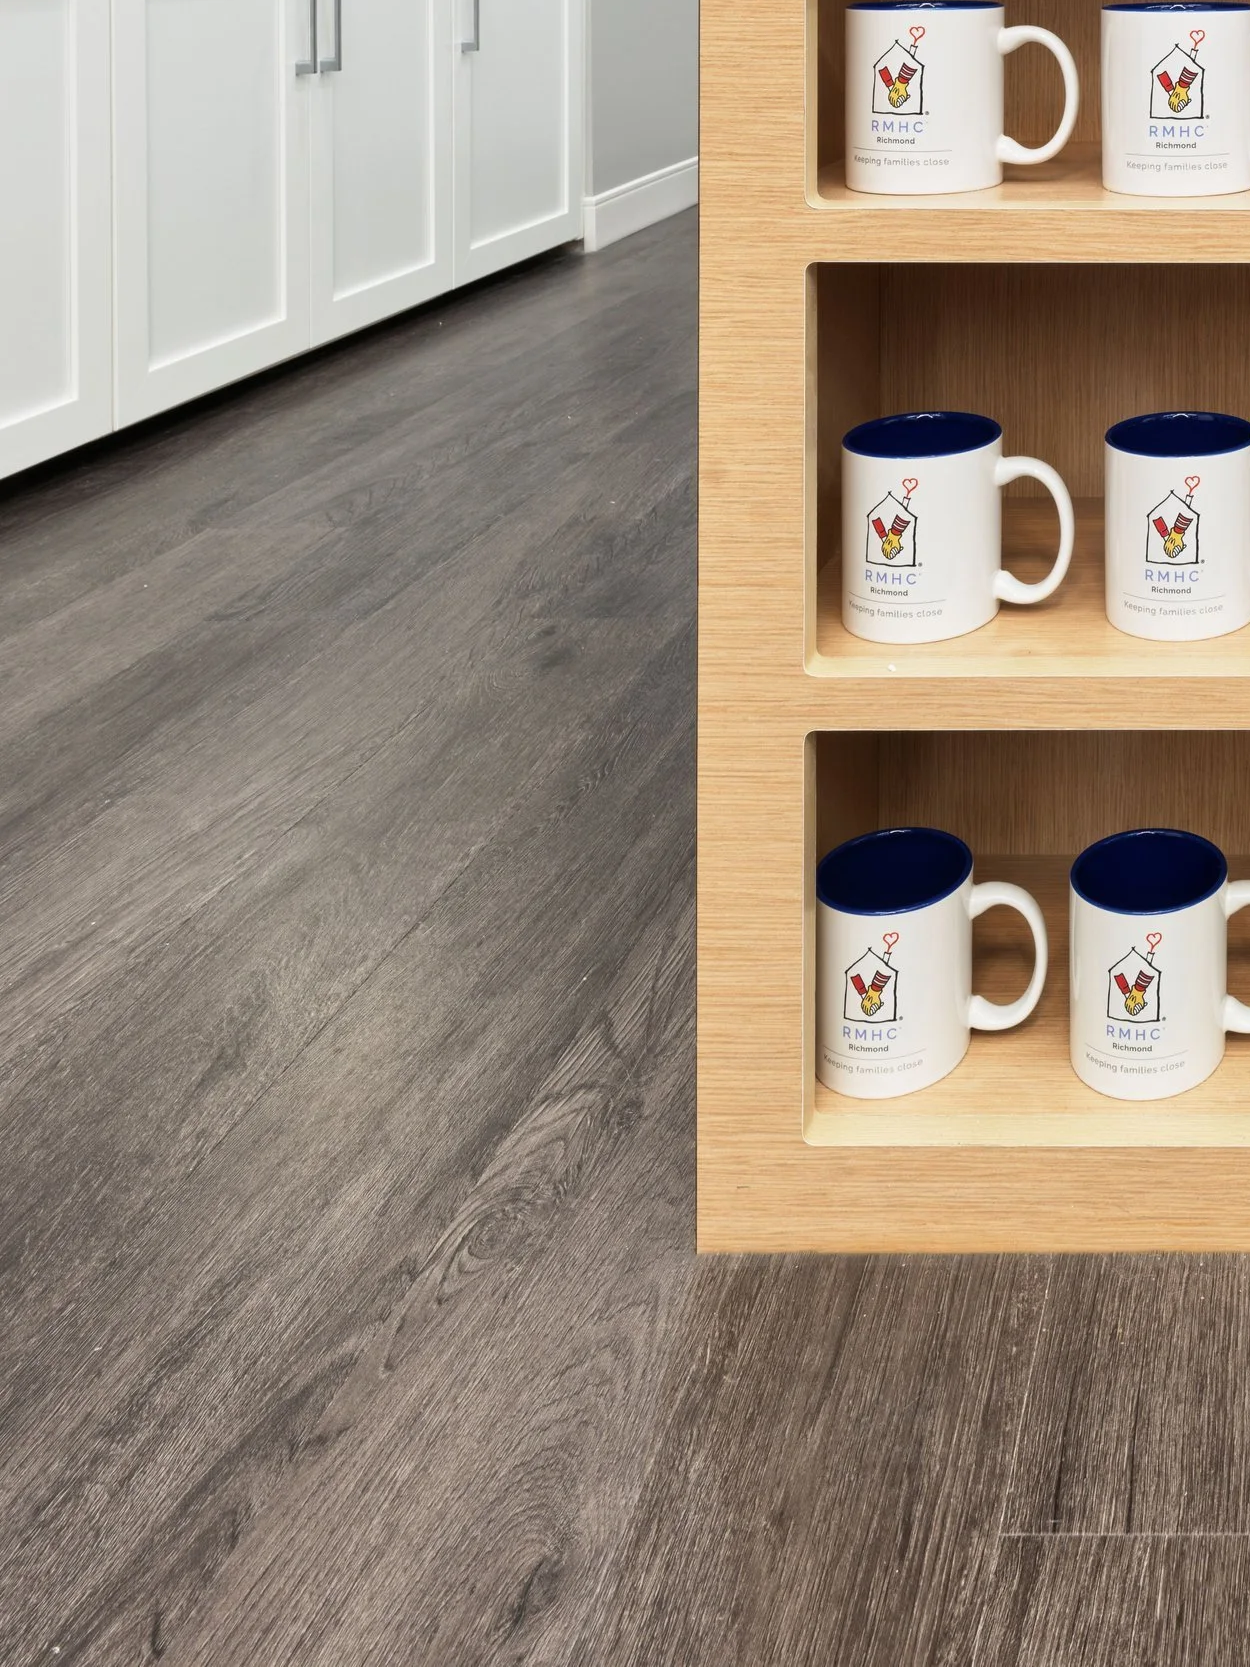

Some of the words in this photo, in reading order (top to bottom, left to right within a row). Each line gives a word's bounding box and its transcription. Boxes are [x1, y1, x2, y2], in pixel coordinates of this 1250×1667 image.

[872, 120, 923, 133] RMHC
[1149, 125, 1204, 137] RMHC
[854, 155, 881, 166] Keeping
[884, 158, 920, 166] families
[1126, 161, 1160, 171] Keeping
[1164, 163, 1201, 171] families
[865, 569, 916, 585] RMHC
[1145, 569, 1199, 582] RMHC
[870, 587, 908, 596] Richmond
[1152, 586, 1191, 594] Richmond
[849, 600, 874, 617] Keeping
[877, 609, 913, 618] families
[917, 609, 942, 617] close
[1124, 600, 1156, 616] Keeping
[1159, 607, 1196, 616] families
[1200, 604, 1223, 614] close
[843, 1026, 897, 1041] RMHC
[1106, 1025, 1160, 1040] RMHC
[849, 1044, 889, 1052] Richmond
[1112, 1043, 1152, 1052] Richmond
[824, 1054, 853, 1074] Keeping
[857, 1066, 894, 1074] families
[898, 1059, 923, 1071] close
[1086, 1052, 1117, 1073] Keeping
[1120, 1065, 1157, 1074] families
[1161, 1061, 1185, 1072] close
